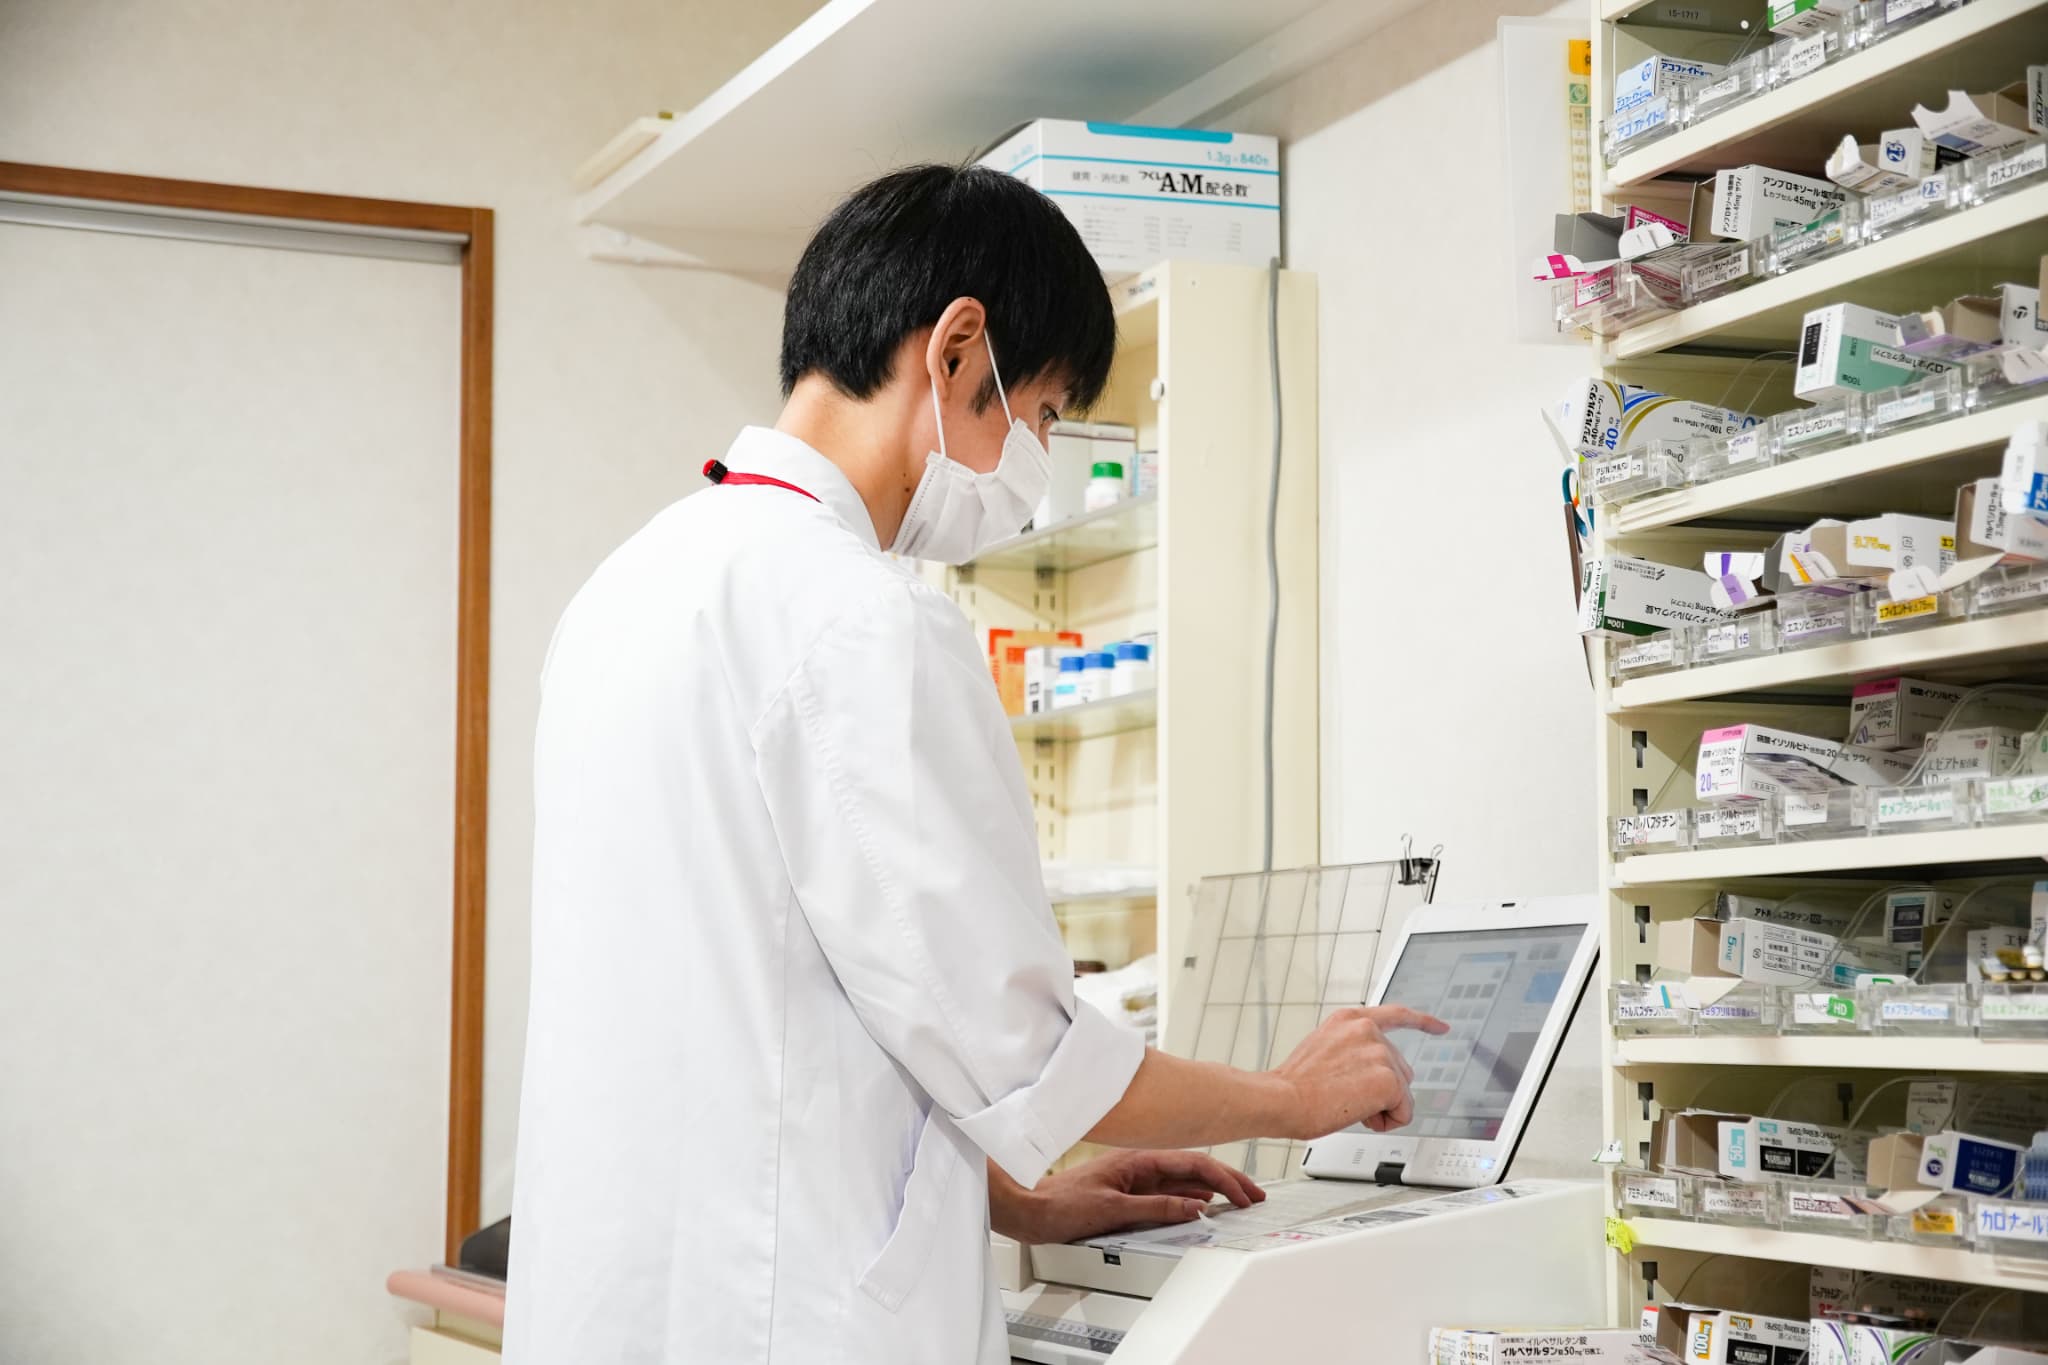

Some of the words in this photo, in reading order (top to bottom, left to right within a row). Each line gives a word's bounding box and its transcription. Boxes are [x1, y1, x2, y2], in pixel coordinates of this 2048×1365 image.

[1581, 383, 1599, 444] アジルサルタン
[1738, 632, 1750, 645] 15
[1833, 1003, 1848, 1016] HD
[1526, 1335, 1588, 1346] イルベサルタン錠
